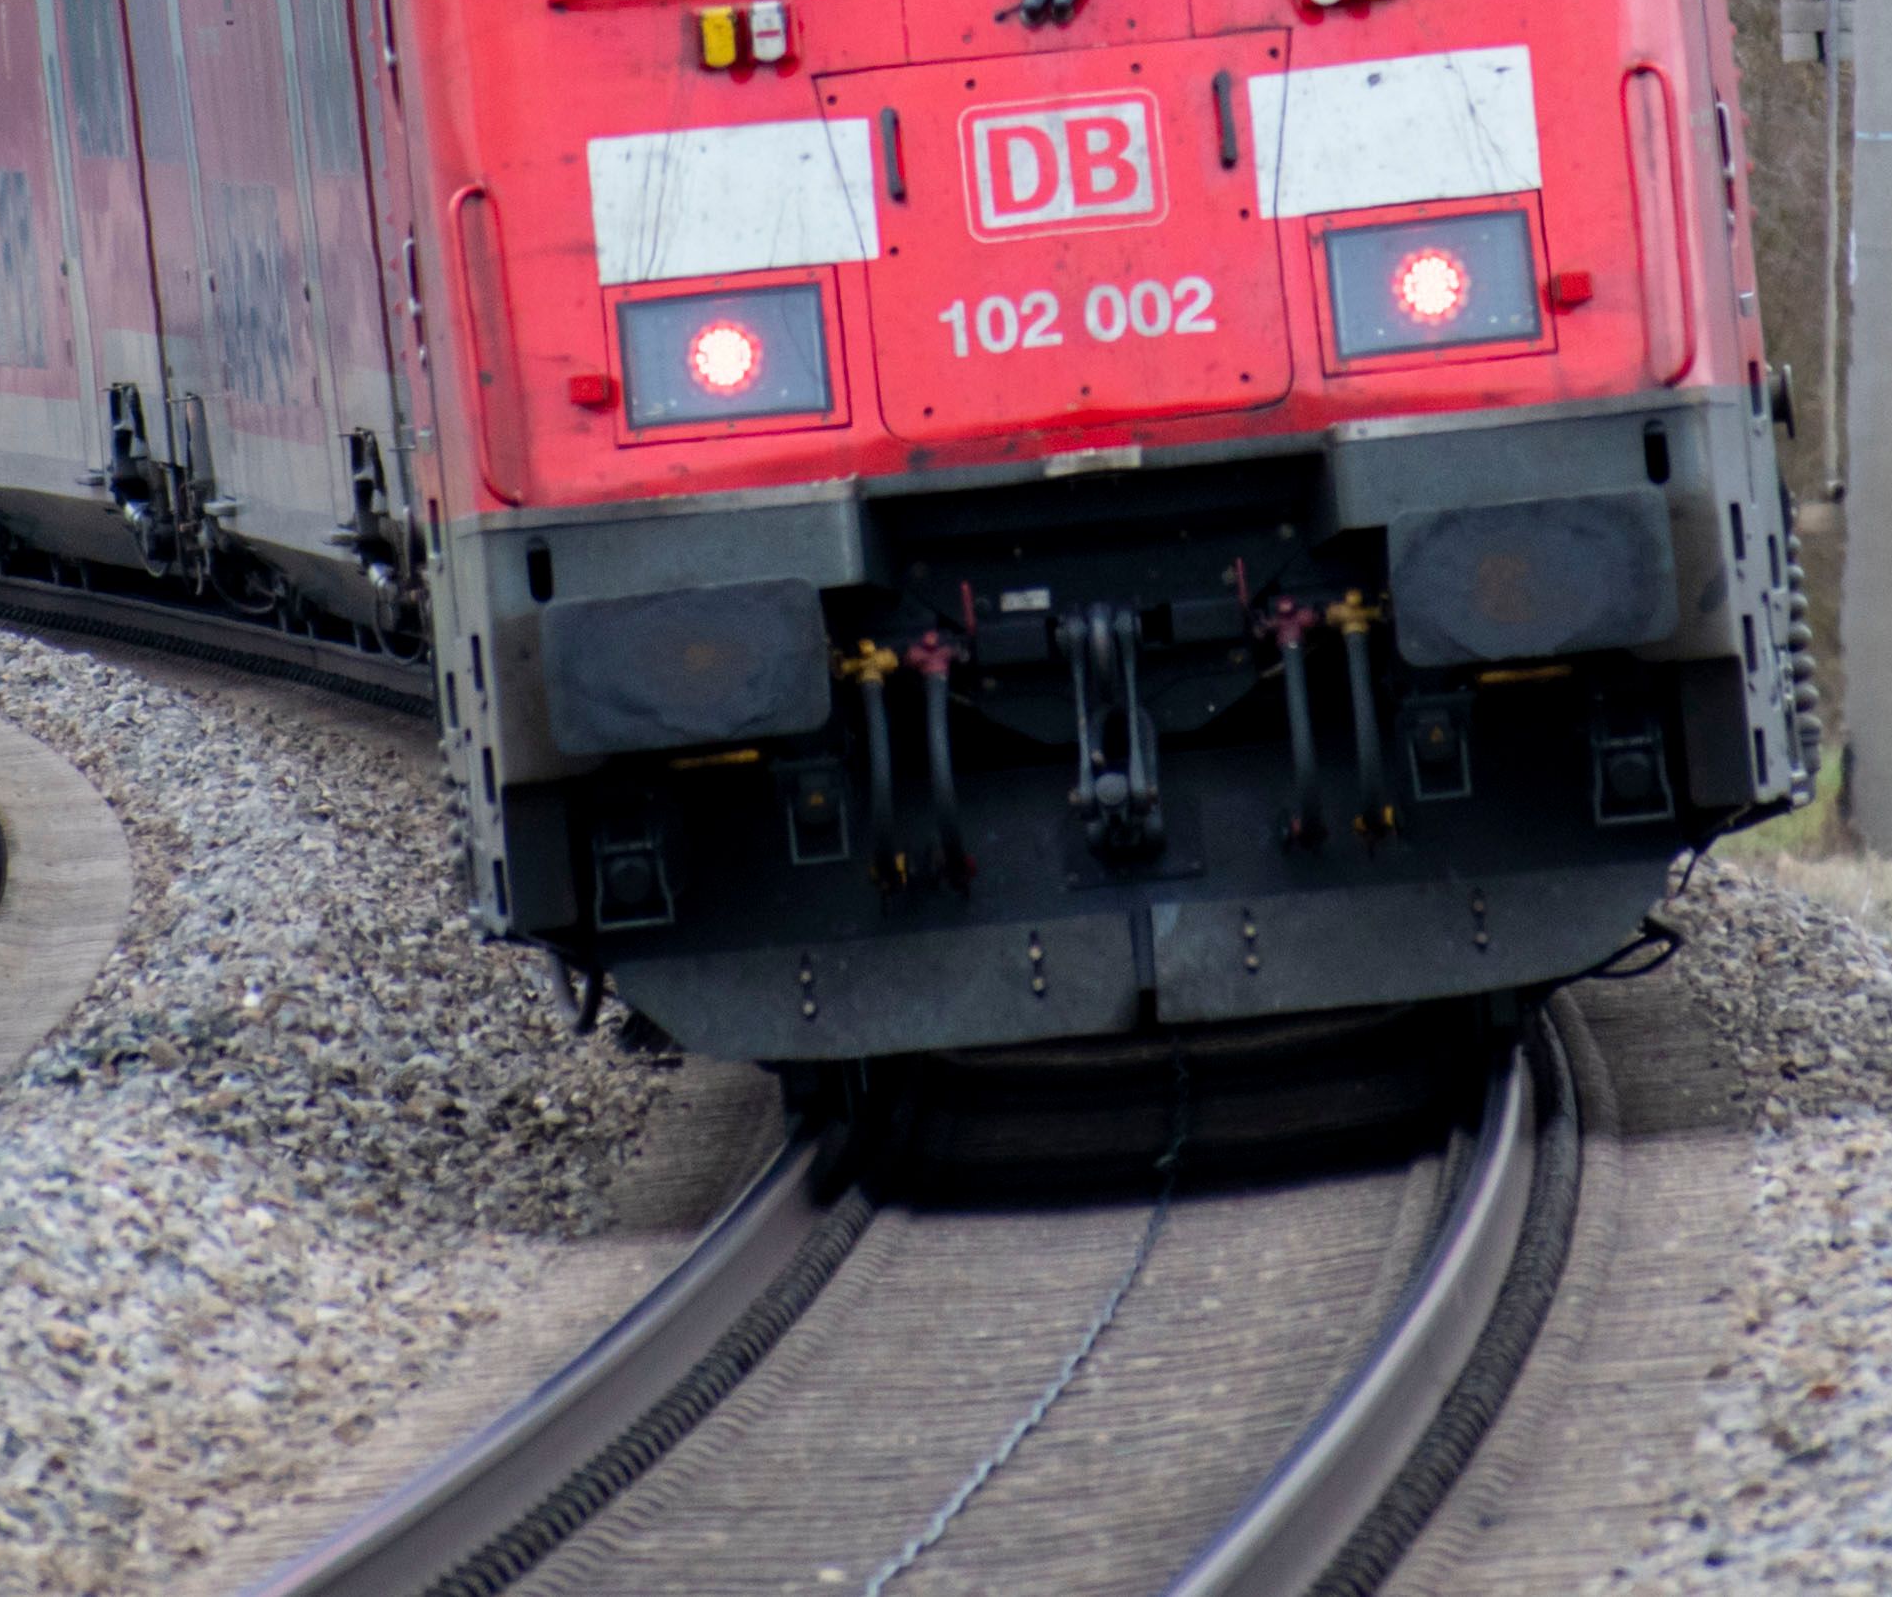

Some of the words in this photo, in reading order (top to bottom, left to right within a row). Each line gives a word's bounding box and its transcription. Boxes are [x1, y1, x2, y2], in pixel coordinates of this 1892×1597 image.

[986, 116, 1140, 218] DB
[939, 289, 1063, 358] 102
[1084, 275, 1216, 343] 002
